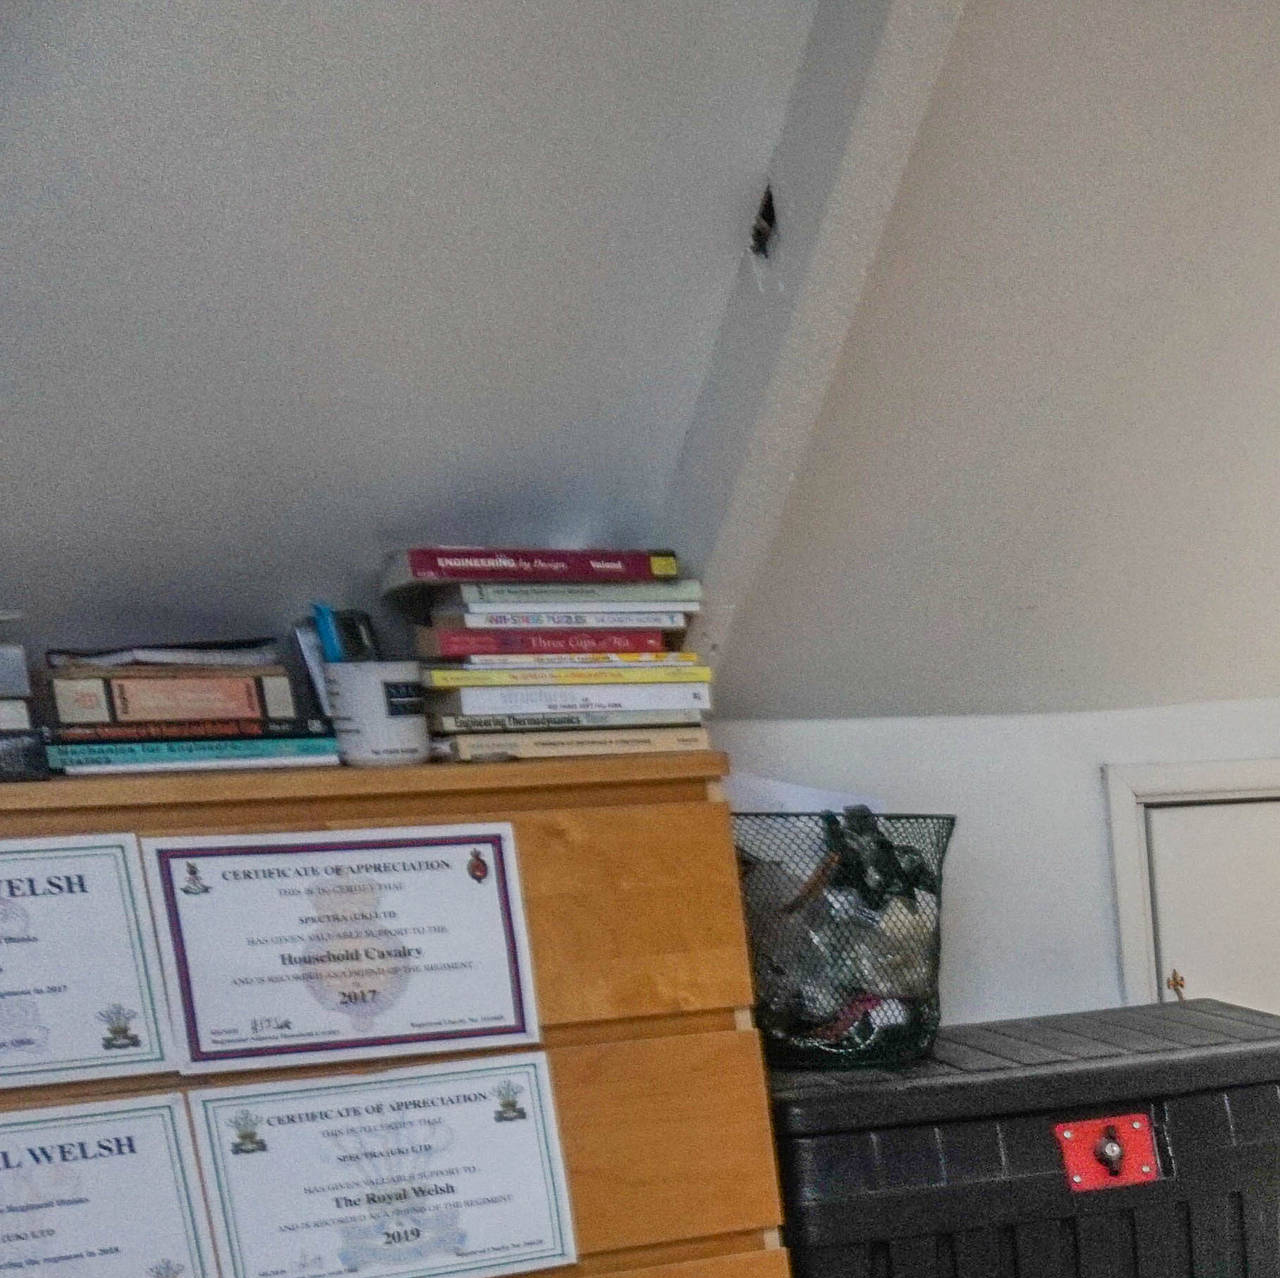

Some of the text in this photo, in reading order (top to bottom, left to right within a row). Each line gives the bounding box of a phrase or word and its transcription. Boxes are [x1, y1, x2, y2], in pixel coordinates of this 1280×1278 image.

[437, 557, 516, 569] ENGINEERING
[530, 636, 565, 647] Three
[569, 636, 596, 648] Cups
[610, 637, 630, 646] Tea
[454, 716, 506, 728] Engineering
[507, 714, 581, 726] Thermodynamics
[222, 860, 450, 881] CERTIFICATE OF APPRECIATION
[280, 946, 423, 966] Household Cavalry
[338, 990, 377, 1005] 2017
[267, 1092, 488, 1127] CERTIFICATE OF APPRECIATION
[27, 1136, 136, 1164] WELSH
[334, 1183, 455, 1209] The Royal Welsh
[383, 1228, 420, 1245] 2019
